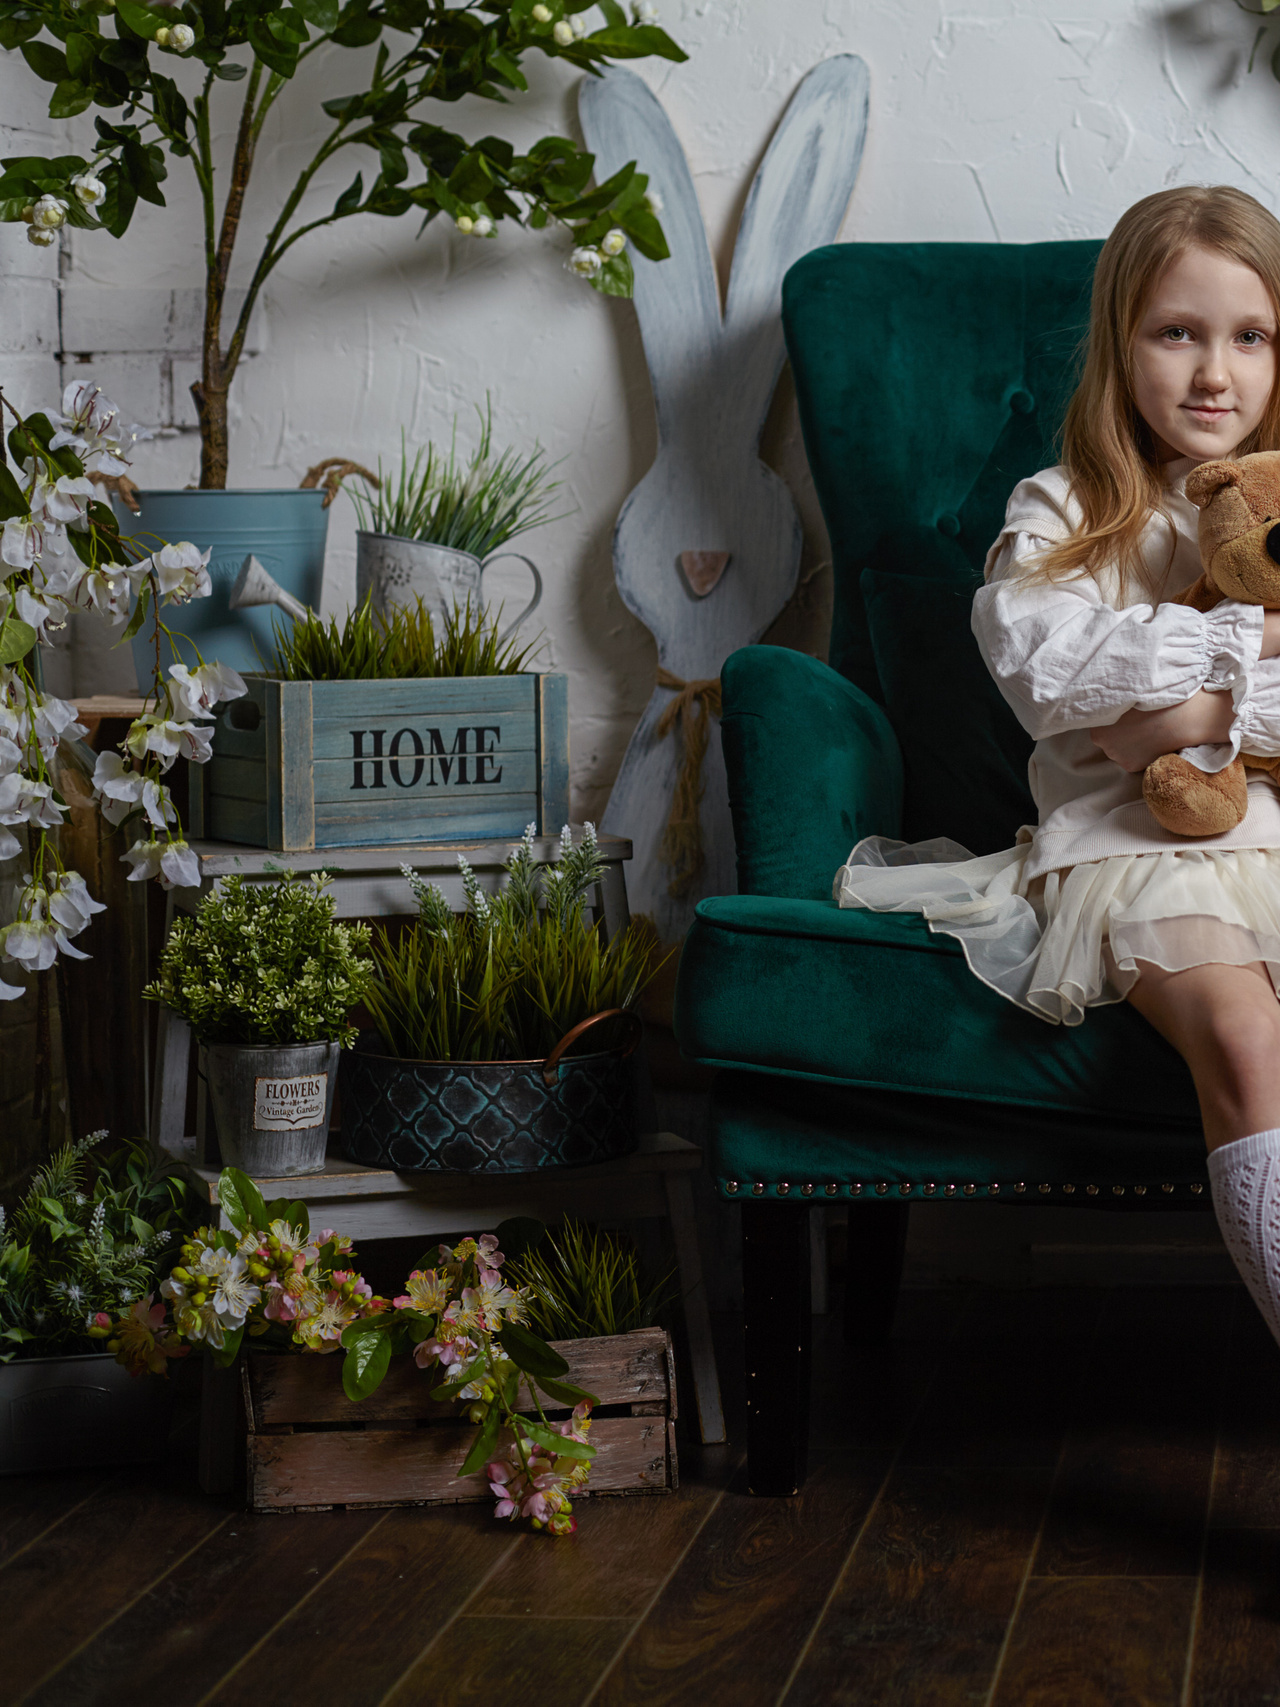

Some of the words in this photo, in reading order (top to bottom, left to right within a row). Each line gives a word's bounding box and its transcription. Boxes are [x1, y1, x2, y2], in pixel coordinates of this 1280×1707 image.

[349, 726, 502, 789] HOME
[265, 1080, 320, 1099] FLOWERS
[267, 1107, 294, 1118] Vintage
[296, 1104, 319, 1115] Garden
